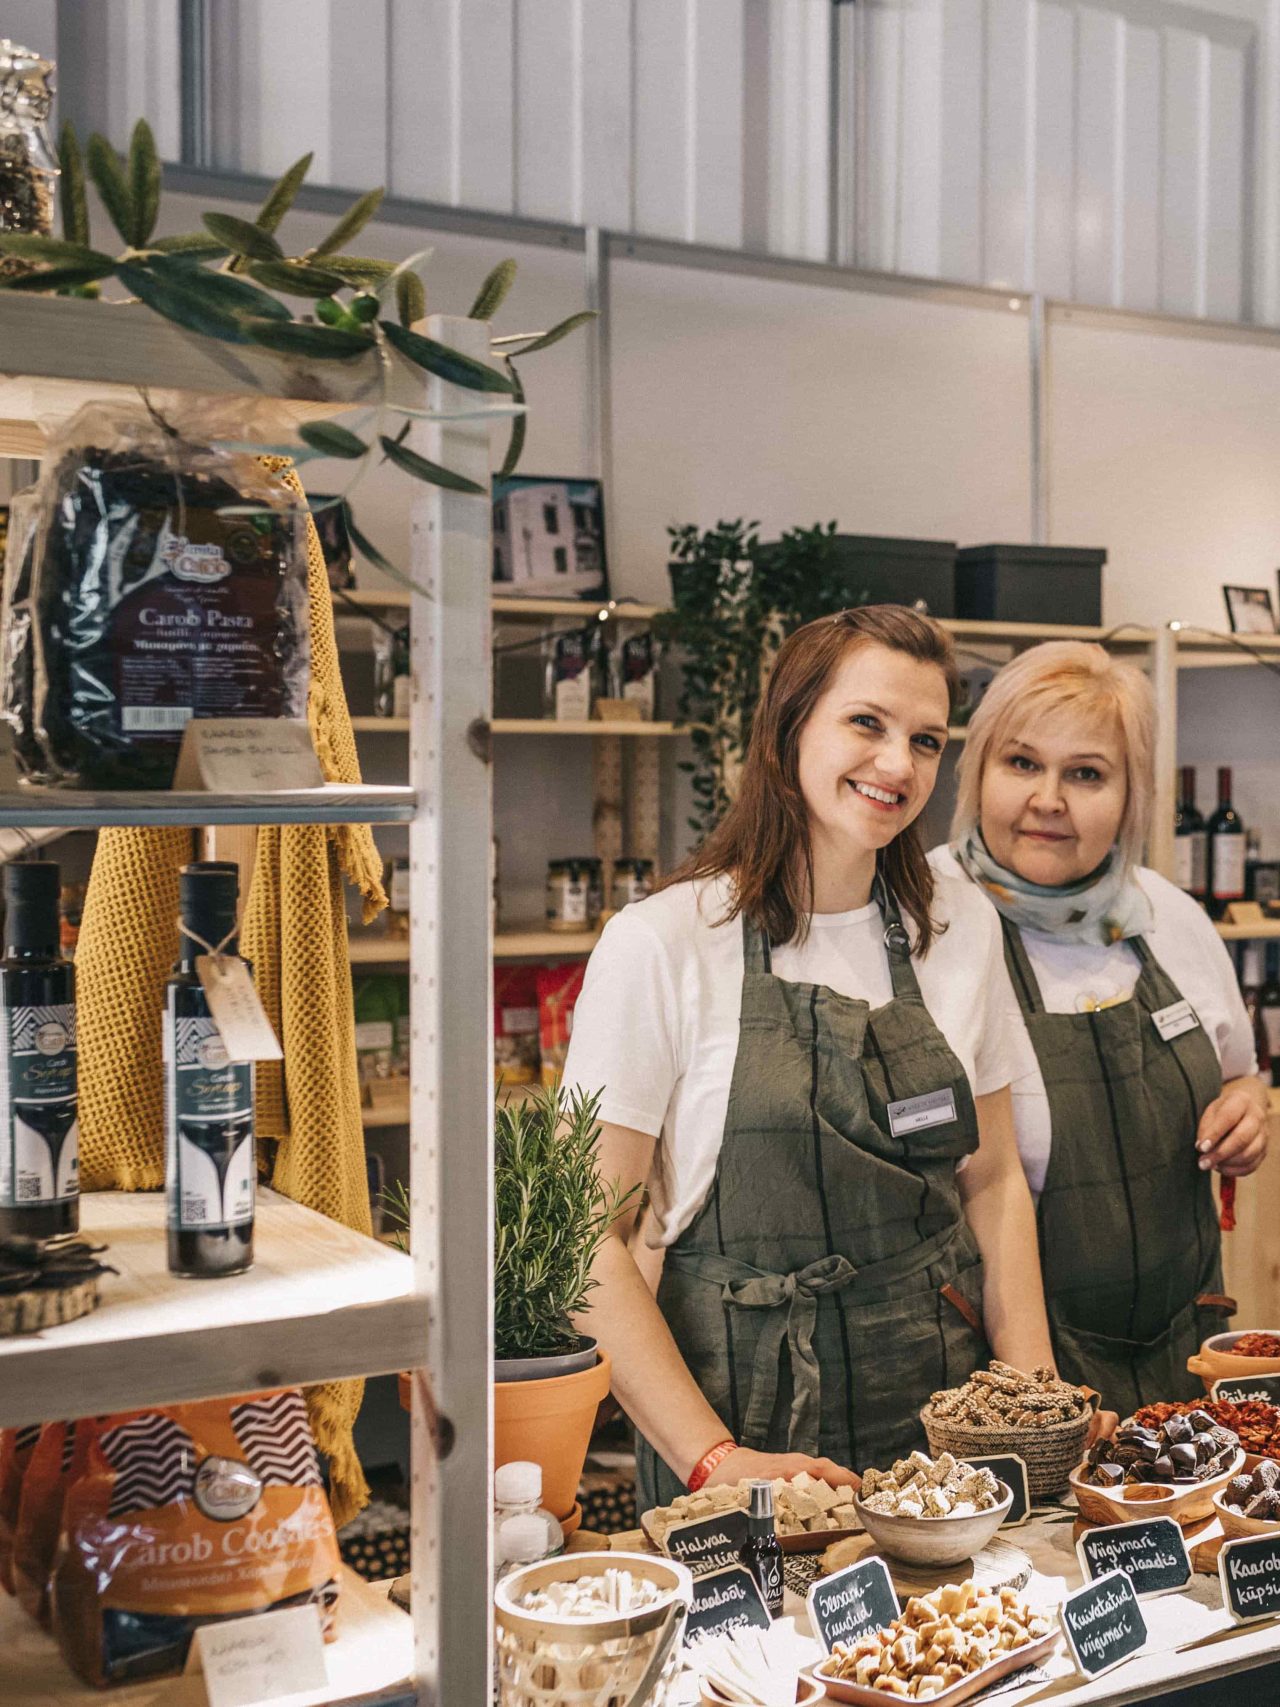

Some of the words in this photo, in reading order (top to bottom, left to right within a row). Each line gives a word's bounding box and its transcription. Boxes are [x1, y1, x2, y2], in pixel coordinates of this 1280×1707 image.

[138, 608, 201, 628] Carob
[207, 610, 254, 629] Pasta
[675, 1531, 732, 1557] Halvaa
[1088, 1531, 1157, 1564] Viigimari
[1067, 1584, 1133, 1632] Kuivatatud
[1079, 1614, 1132, 1660] viigimari
